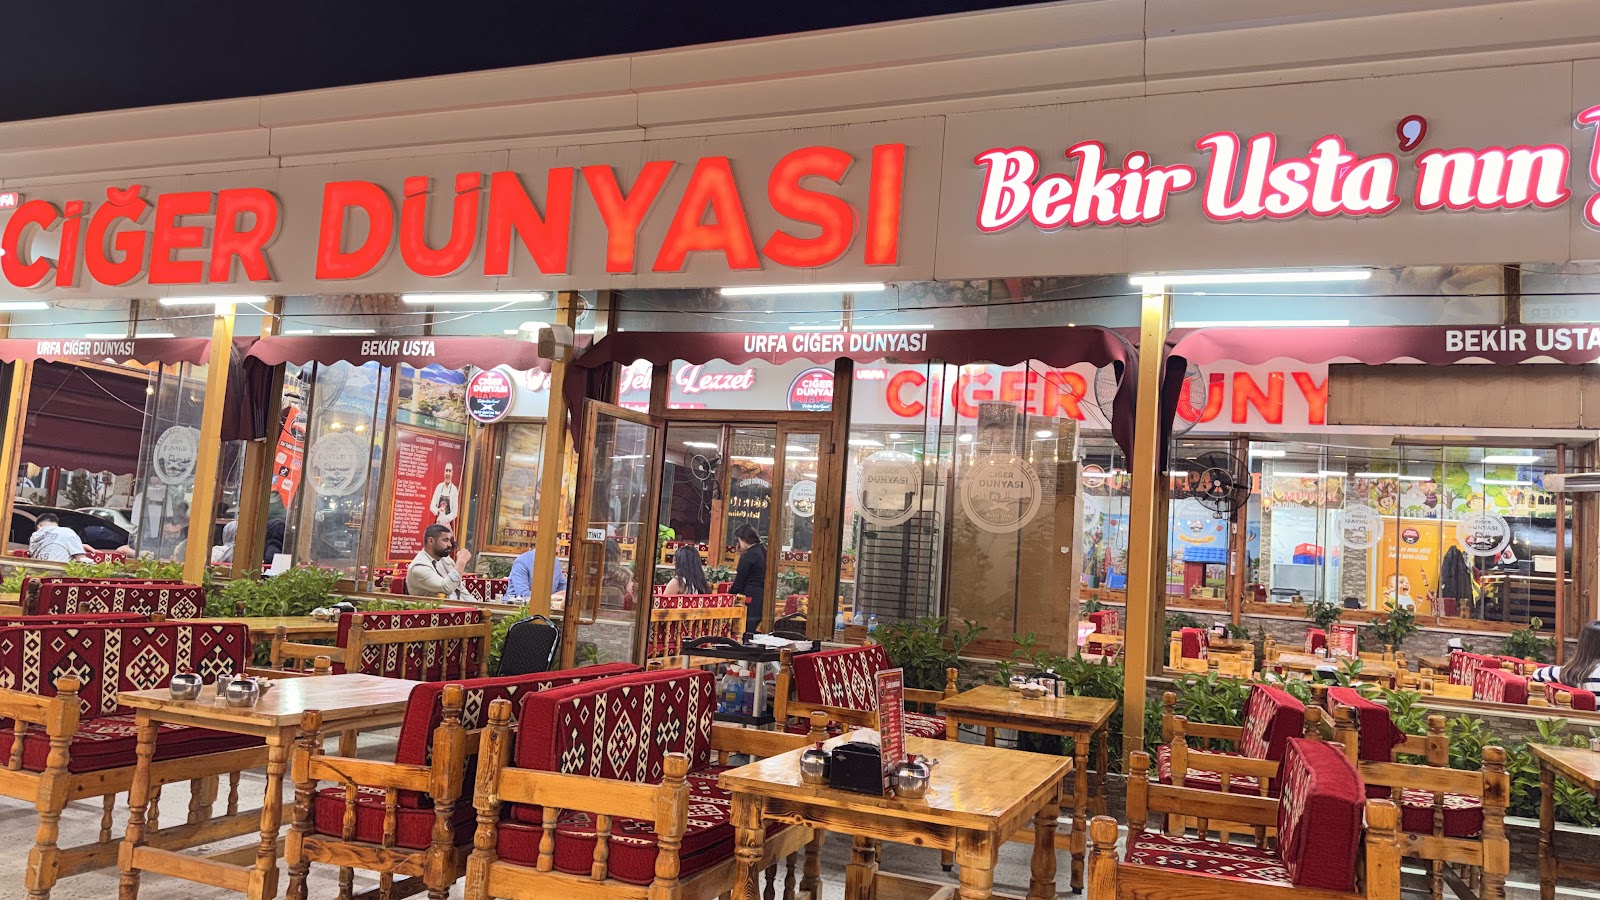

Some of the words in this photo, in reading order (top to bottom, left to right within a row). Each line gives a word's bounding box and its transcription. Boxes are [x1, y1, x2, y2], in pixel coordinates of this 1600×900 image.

[974, 139, 1196, 233] Bekir
[1195, 114, 1572, 222] Usta'nın
[0, 194, 15, 207] FA
[1, 184, 278, 287] CİĞER
[316, 143, 905, 280] DÜNYASI
[36, 341, 61, 355] URFA
[63, 339, 92, 355] CİĞER
[361, 338, 400, 356] BEKİR
[402, 340, 436, 356] USTA
[744, 335, 788, 353] URFA
[792, 332, 845, 353] CİĞER
[849, 331, 927, 352] DÜNYASI
[1446, 326, 1527, 352] BEKİR
[1535, 327, 1600, 351] USTA
[675, 364, 754, 394] Lezzet
[885, 364, 1088, 422] CİĞER
